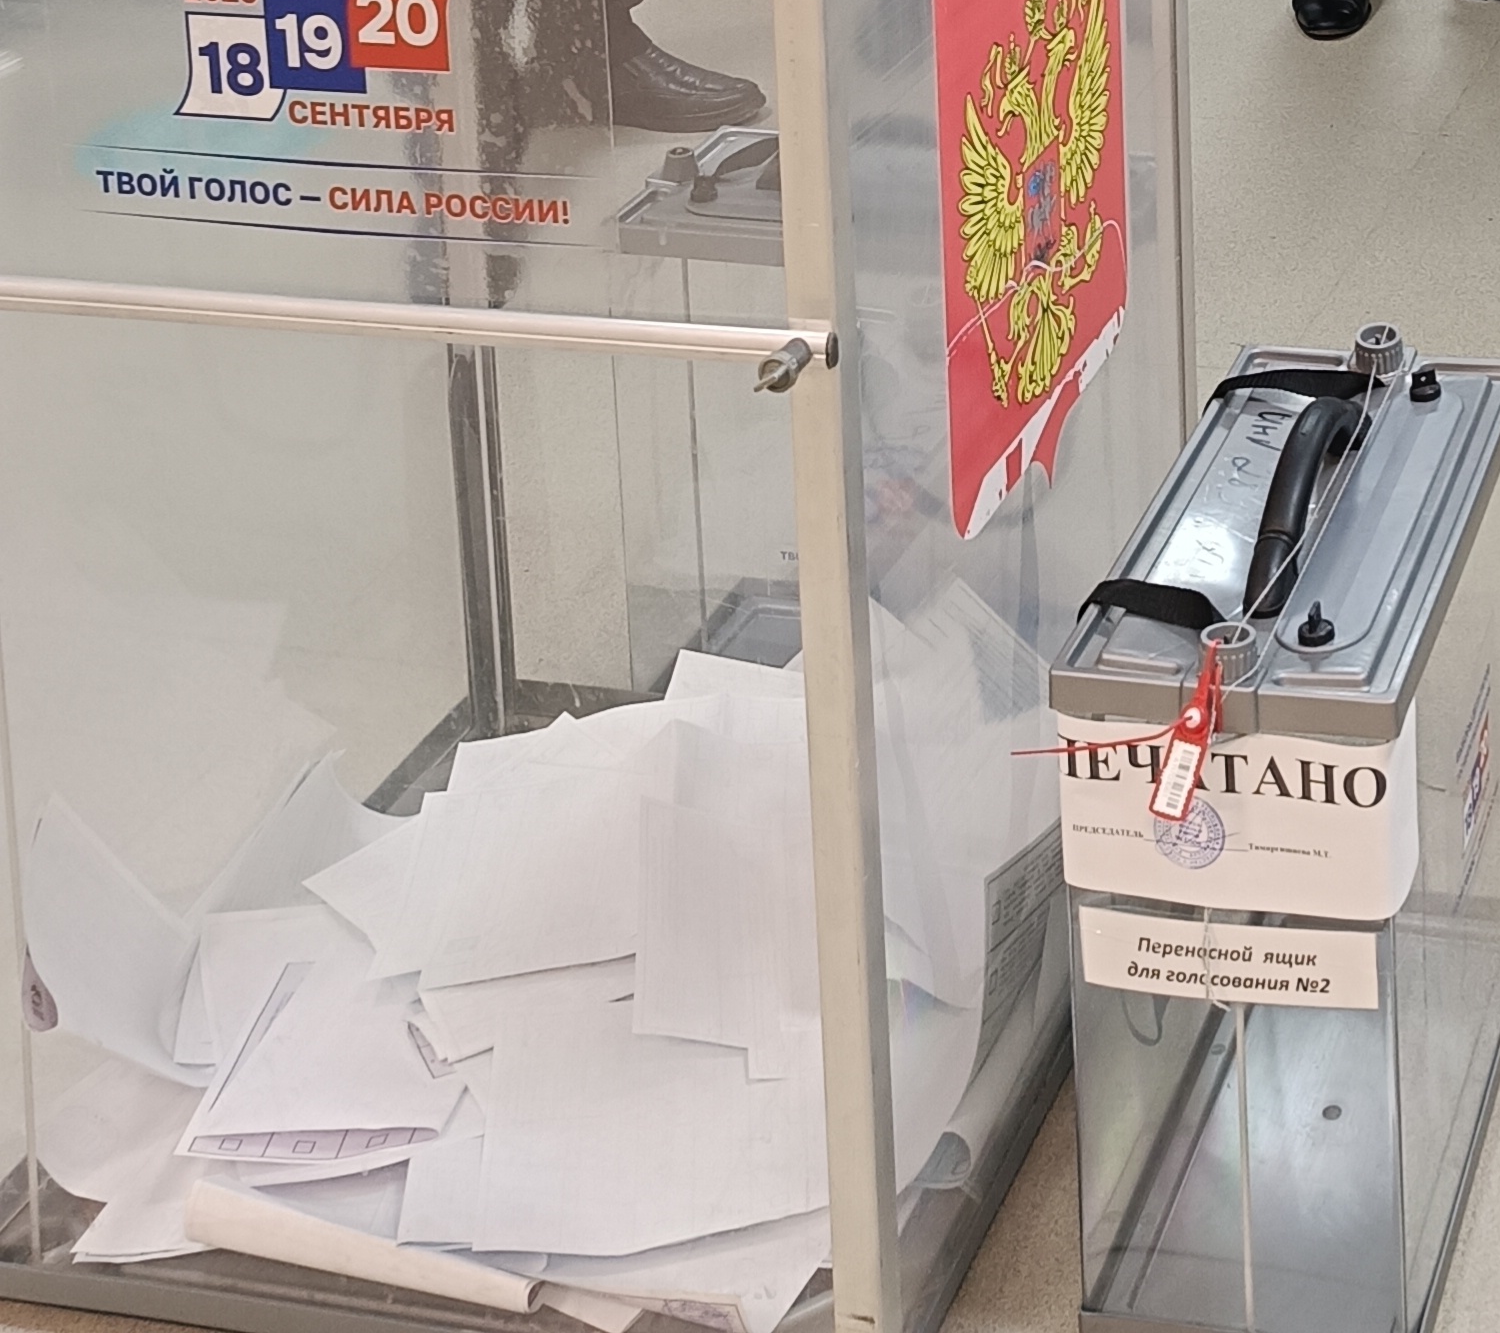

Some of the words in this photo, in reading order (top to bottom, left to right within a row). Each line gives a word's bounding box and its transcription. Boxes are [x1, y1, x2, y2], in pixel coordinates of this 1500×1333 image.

[275, 13, 343, 71] 19
[198, 41, 264, 97] 18
[288, 100, 455, 134] СЕНТЯБРЯ
[96, 169, 180, 200] ТВОЙ
[187, 176, 292, 207] ГОЛОС
[329, 186, 417, 217] СИЛА
[424, 193, 571, 225] РОССИИ!
[1058, 733, 1387, 808] ПЕЧТАНО
[1072, 824, 1144, 838] ПРЕДСЕДАТЕЛЬ
[1137, 937, 1253, 963] Переносной
[1263, 951, 1317, 968] ящик
[1127, 961, 1161, 980] для
[1295, 977, 1331, 994] №2
